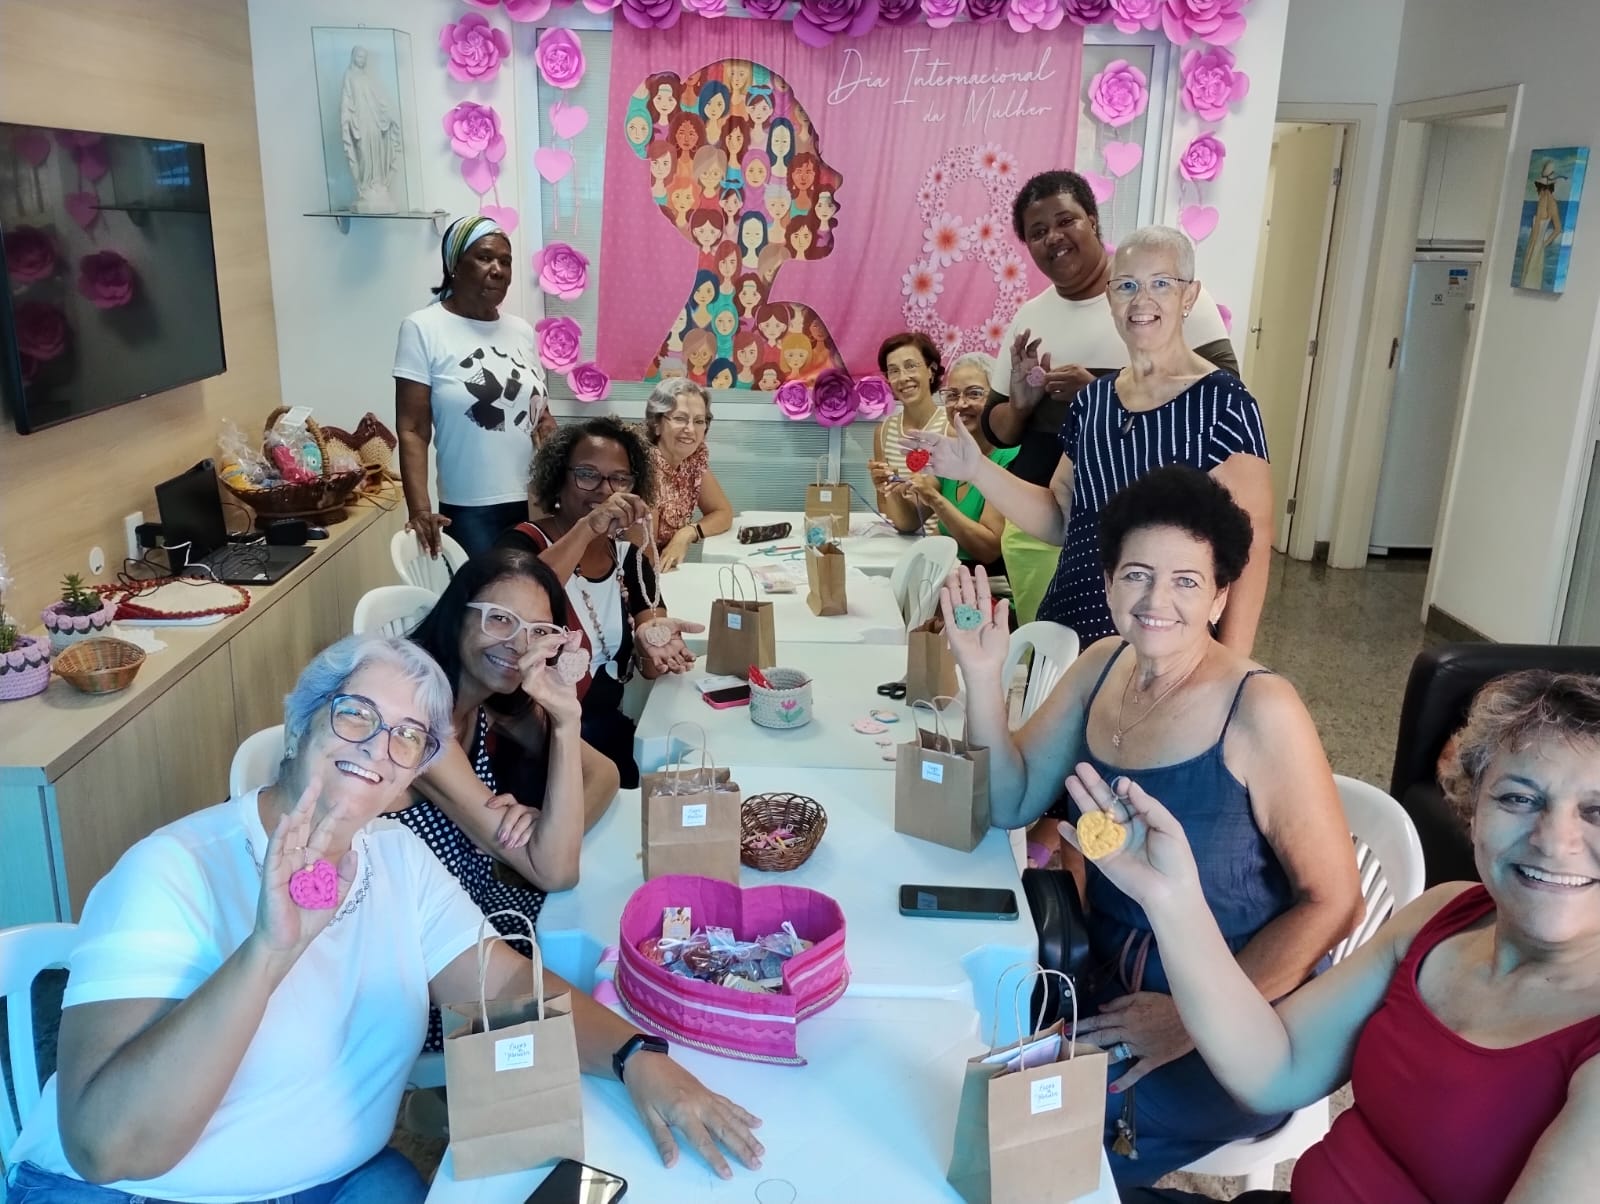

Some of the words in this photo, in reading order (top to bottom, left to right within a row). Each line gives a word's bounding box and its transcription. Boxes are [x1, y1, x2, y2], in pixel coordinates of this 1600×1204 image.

[828, 48, 889, 105] Dia
[894, 46, 1056, 105] Internacional
[923, 102, 945, 123] da
[963, 87, 1052, 135] Mulher
